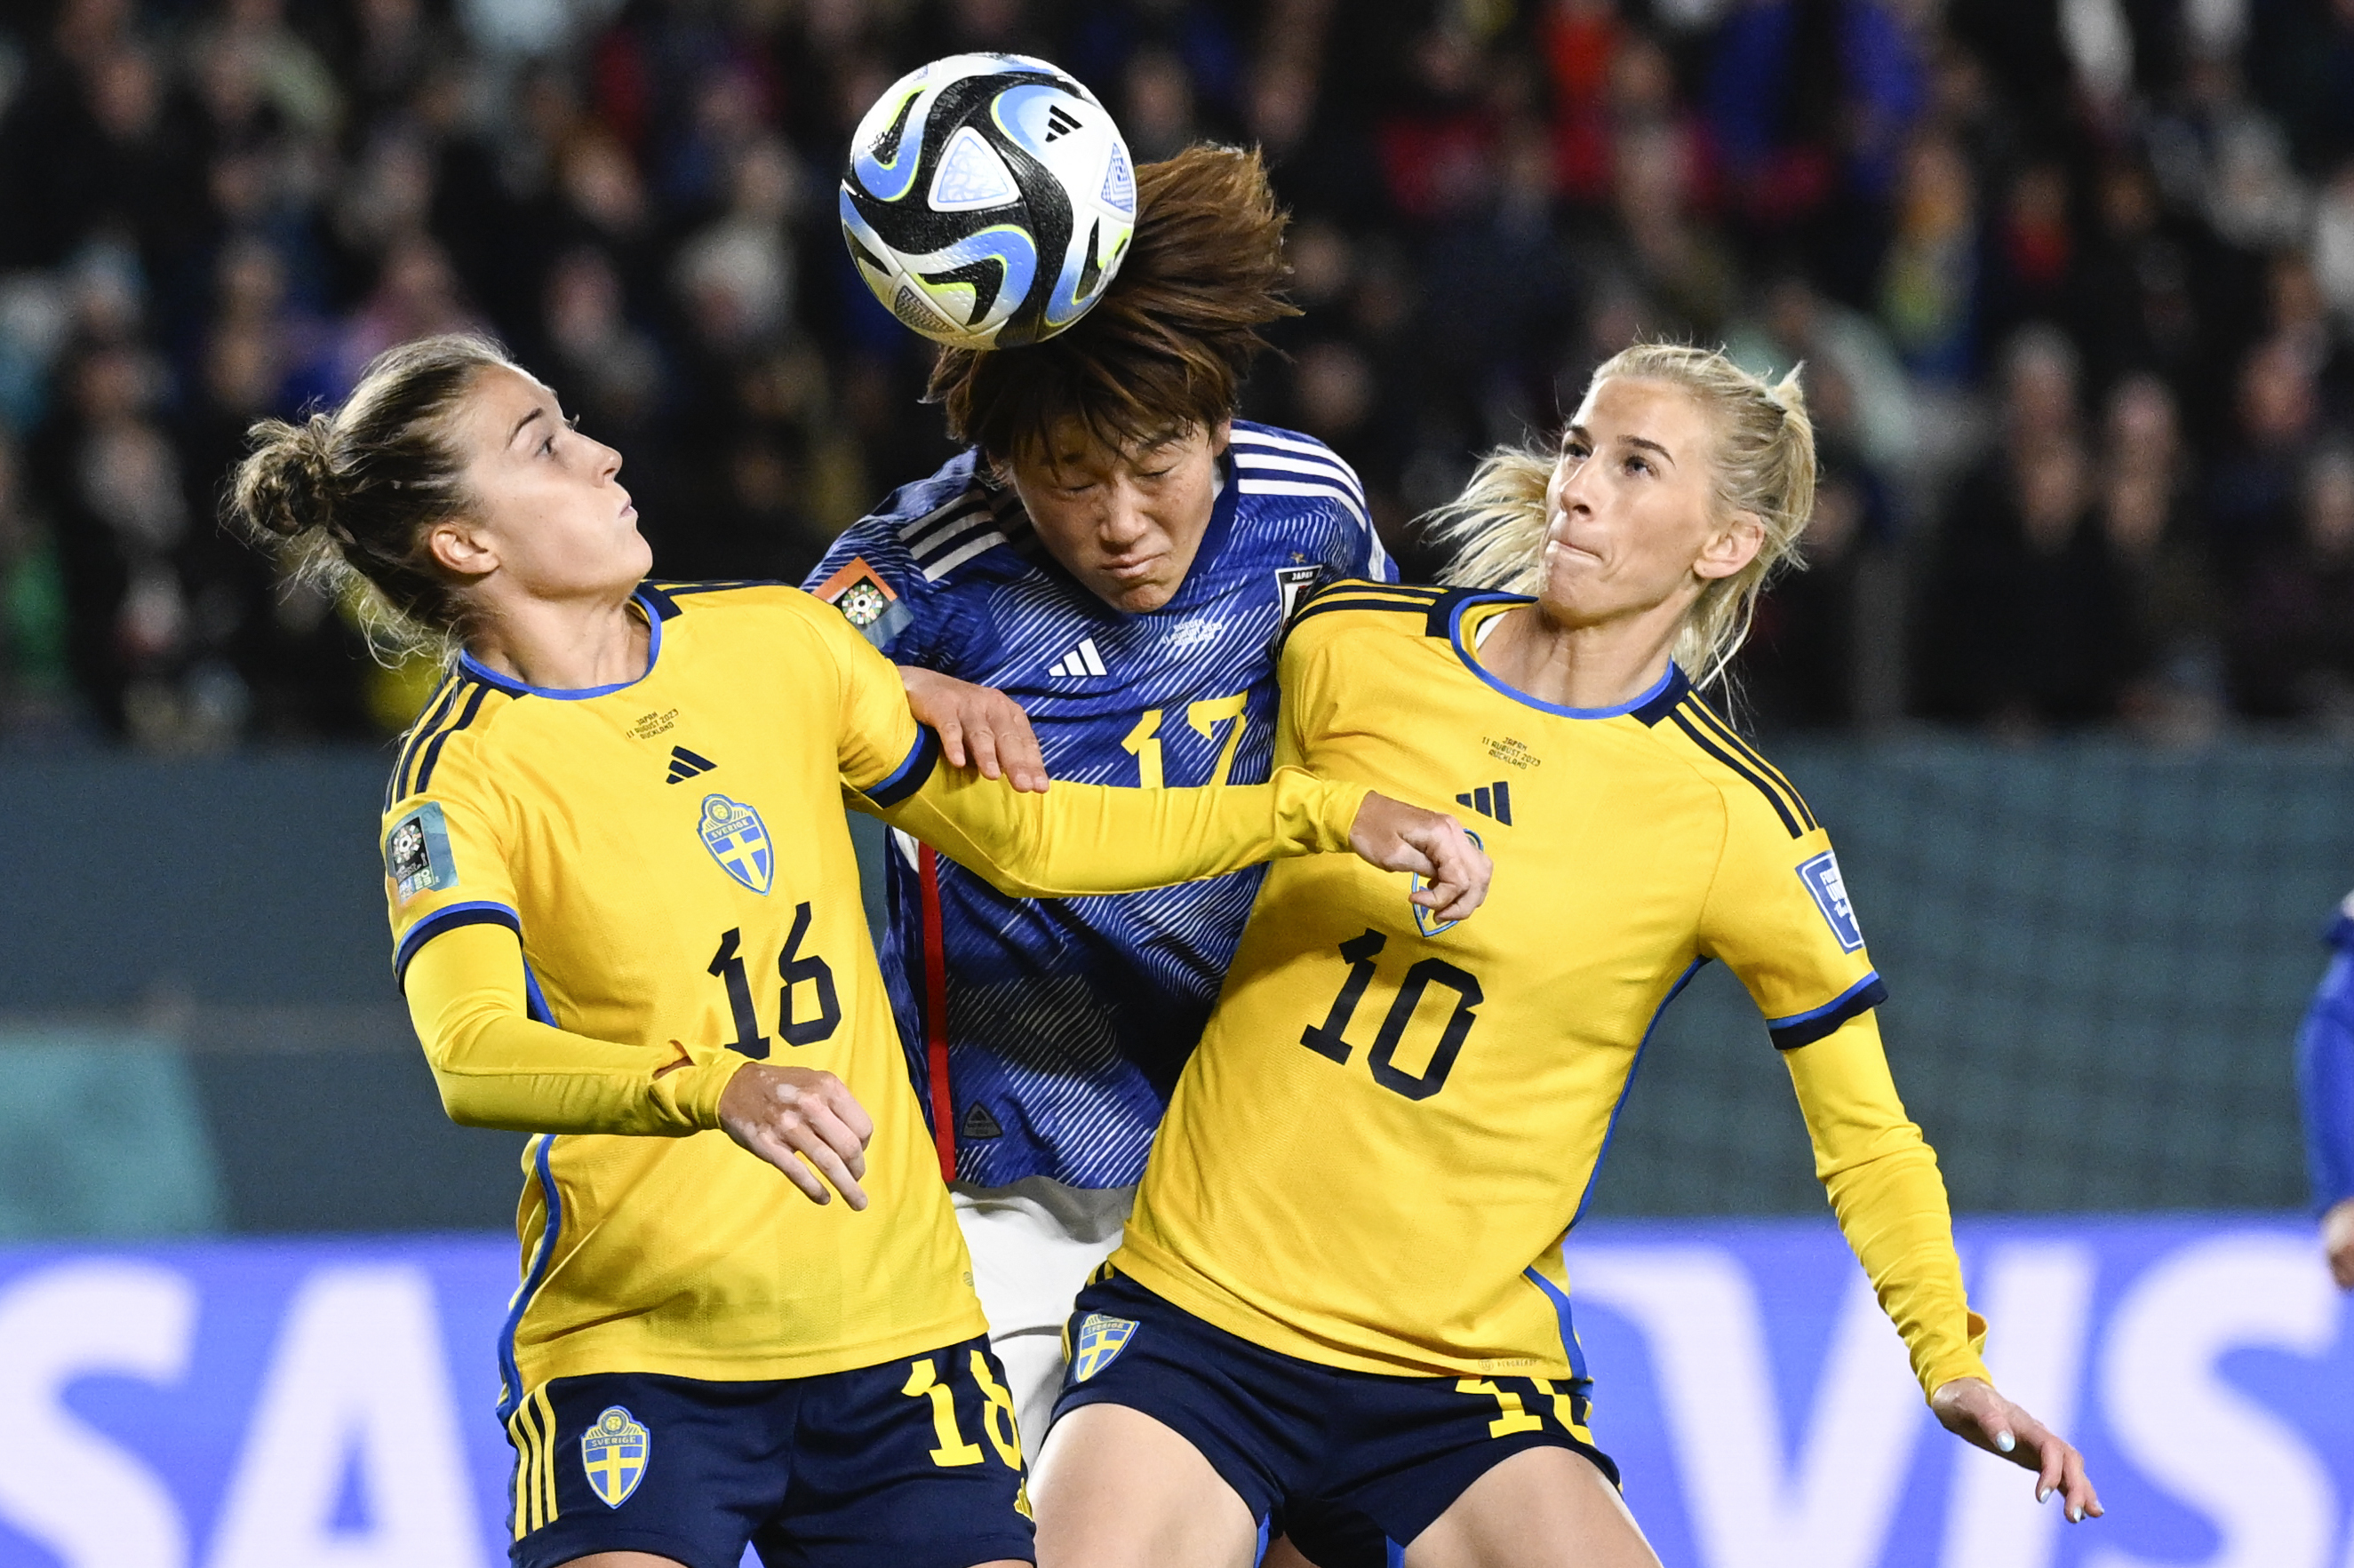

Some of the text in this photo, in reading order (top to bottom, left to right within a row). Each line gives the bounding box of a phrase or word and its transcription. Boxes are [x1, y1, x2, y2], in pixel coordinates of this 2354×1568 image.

[626, 729, 634, 739] 11
[658, 708, 679, 724] 2023
[635, 711, 658, 726] JAPAN
[1121, 689, 1249, 789] 17
[1481, 736, 1542, 768] 11 AUGUST 2023
[1502, 736, 1528, 752] JAPAN
[1488, 749, 1528, 770] AUCKLAND
[711, 819, 750, 839] SVERIGE
[707, 901, 842, 1061] 16
[1299, 927, 1485, 1102] 10
[591, 1436, 637, 1447] SVERIGE
